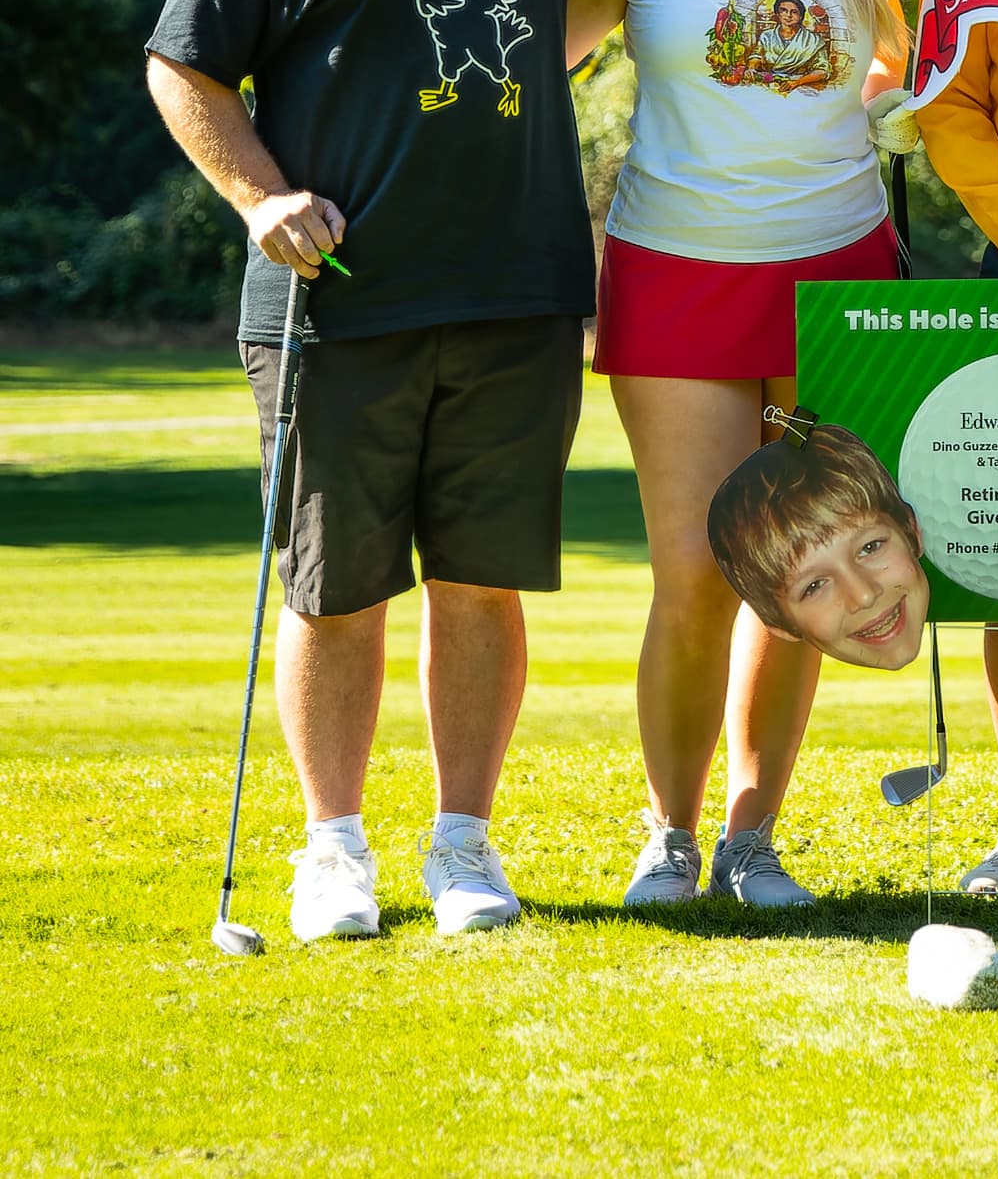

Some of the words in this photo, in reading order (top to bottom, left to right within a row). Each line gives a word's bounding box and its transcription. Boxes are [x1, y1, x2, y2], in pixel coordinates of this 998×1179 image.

[844, 307, 903, 331] This
[909, 307, 973, 330] Hole
[932, 441, 960, 452] Dino
[977, 457, 985, 467] &
[946, 542, 989, 554] Phone
